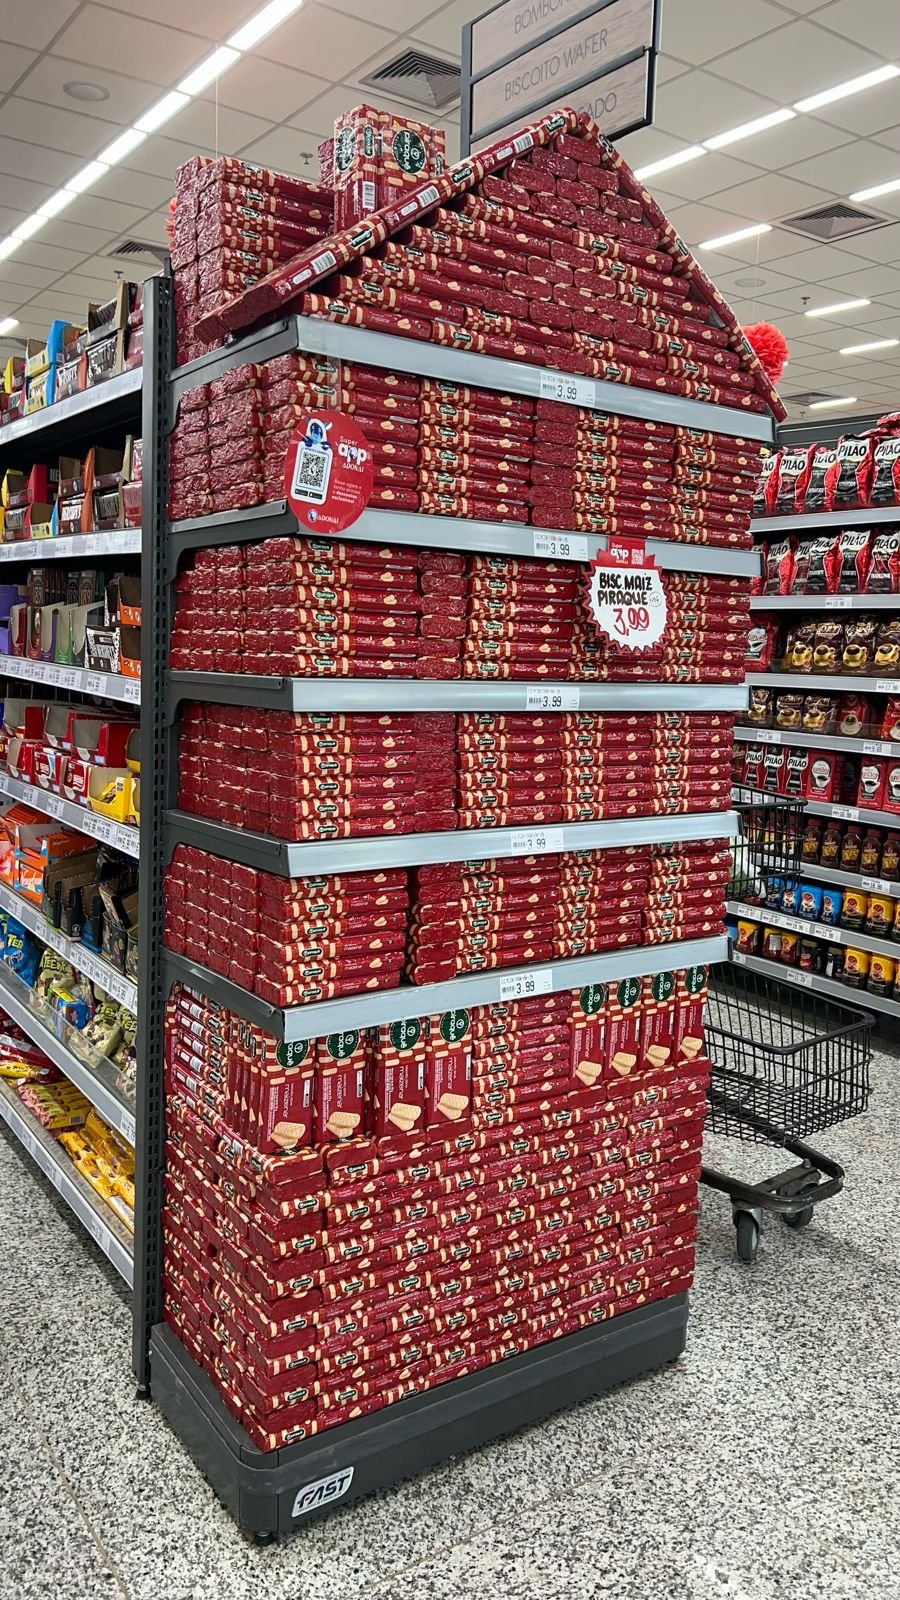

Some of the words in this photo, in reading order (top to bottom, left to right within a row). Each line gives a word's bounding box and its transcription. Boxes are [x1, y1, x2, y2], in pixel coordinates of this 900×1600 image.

[514, 0, 568, 34] BOMBO
[505, 56, 560, 101] BISCOITO
[563, 28, 608, 68] WAFER
[402, 131, 412, 170] piraquê
[557, 384, 577, 400] 3.99
[340, 435, 358, 446] Super
[838, 443, 867, 456] PILÃO
[781, 457, 806, 471] PILÃO
[841, 533, 867, 546] PILÃO
[550, 542, 570, 556] 3.99
[597, 590, 648, 607] PIRAQUE
[613, 607, 650, 636] 3,99
[542, 695, 562, 707] 3.99
[527, 838, 546, 850] 3.99
[516, 980, 535, 994] 3.99
[297, 1474, 351, 1509] FAST
